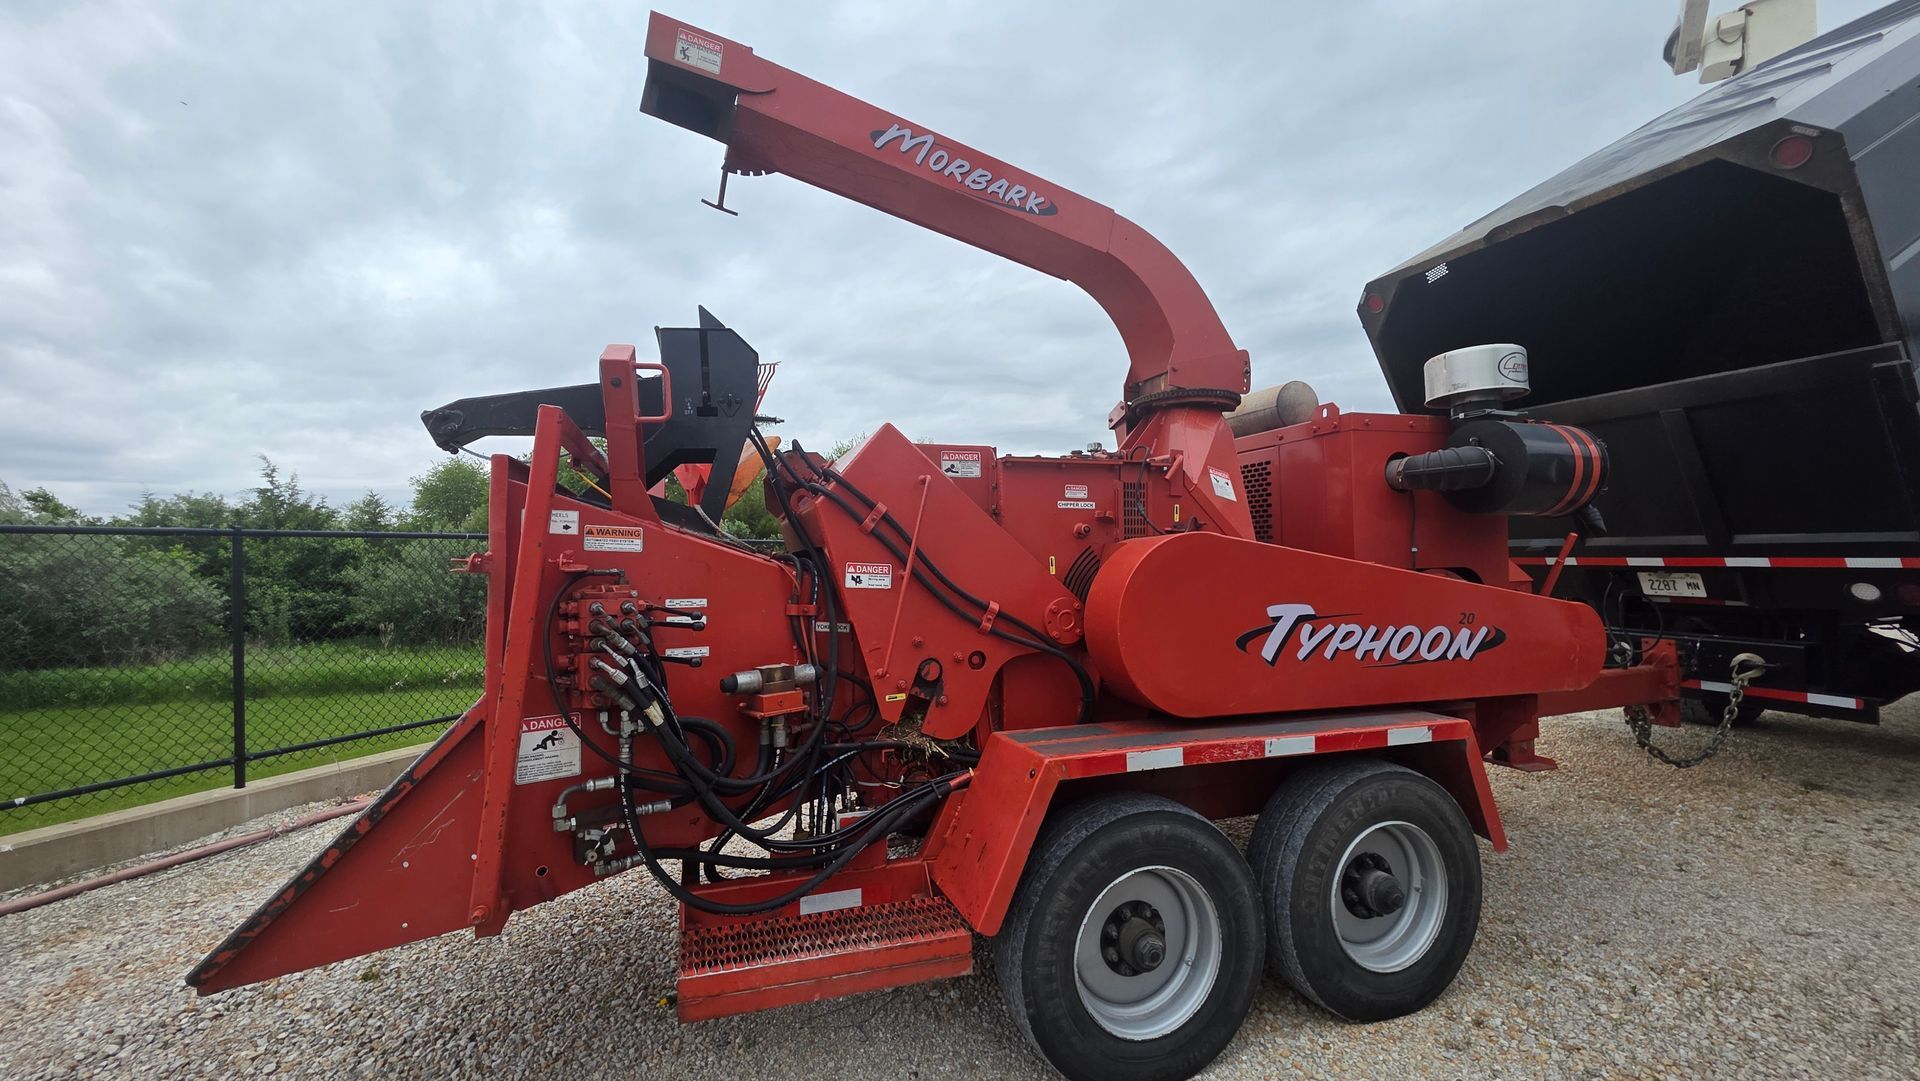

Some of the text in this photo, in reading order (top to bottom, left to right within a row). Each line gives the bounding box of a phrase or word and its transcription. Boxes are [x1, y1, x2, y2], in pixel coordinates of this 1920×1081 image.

[687, 34, 721, 52] DANGER
[874, 123, 1046, 215] MORBARK
[950, 453, 979, 461] DANGER
[596, 528, 641, 538] WARNING
[856, 565, 889, 574] DANGER
[1648, 579, 1678, 592] 2287
[1458, 612, 1476, 626] 20
[1260, 603, 1490, 666] TYPHOON
